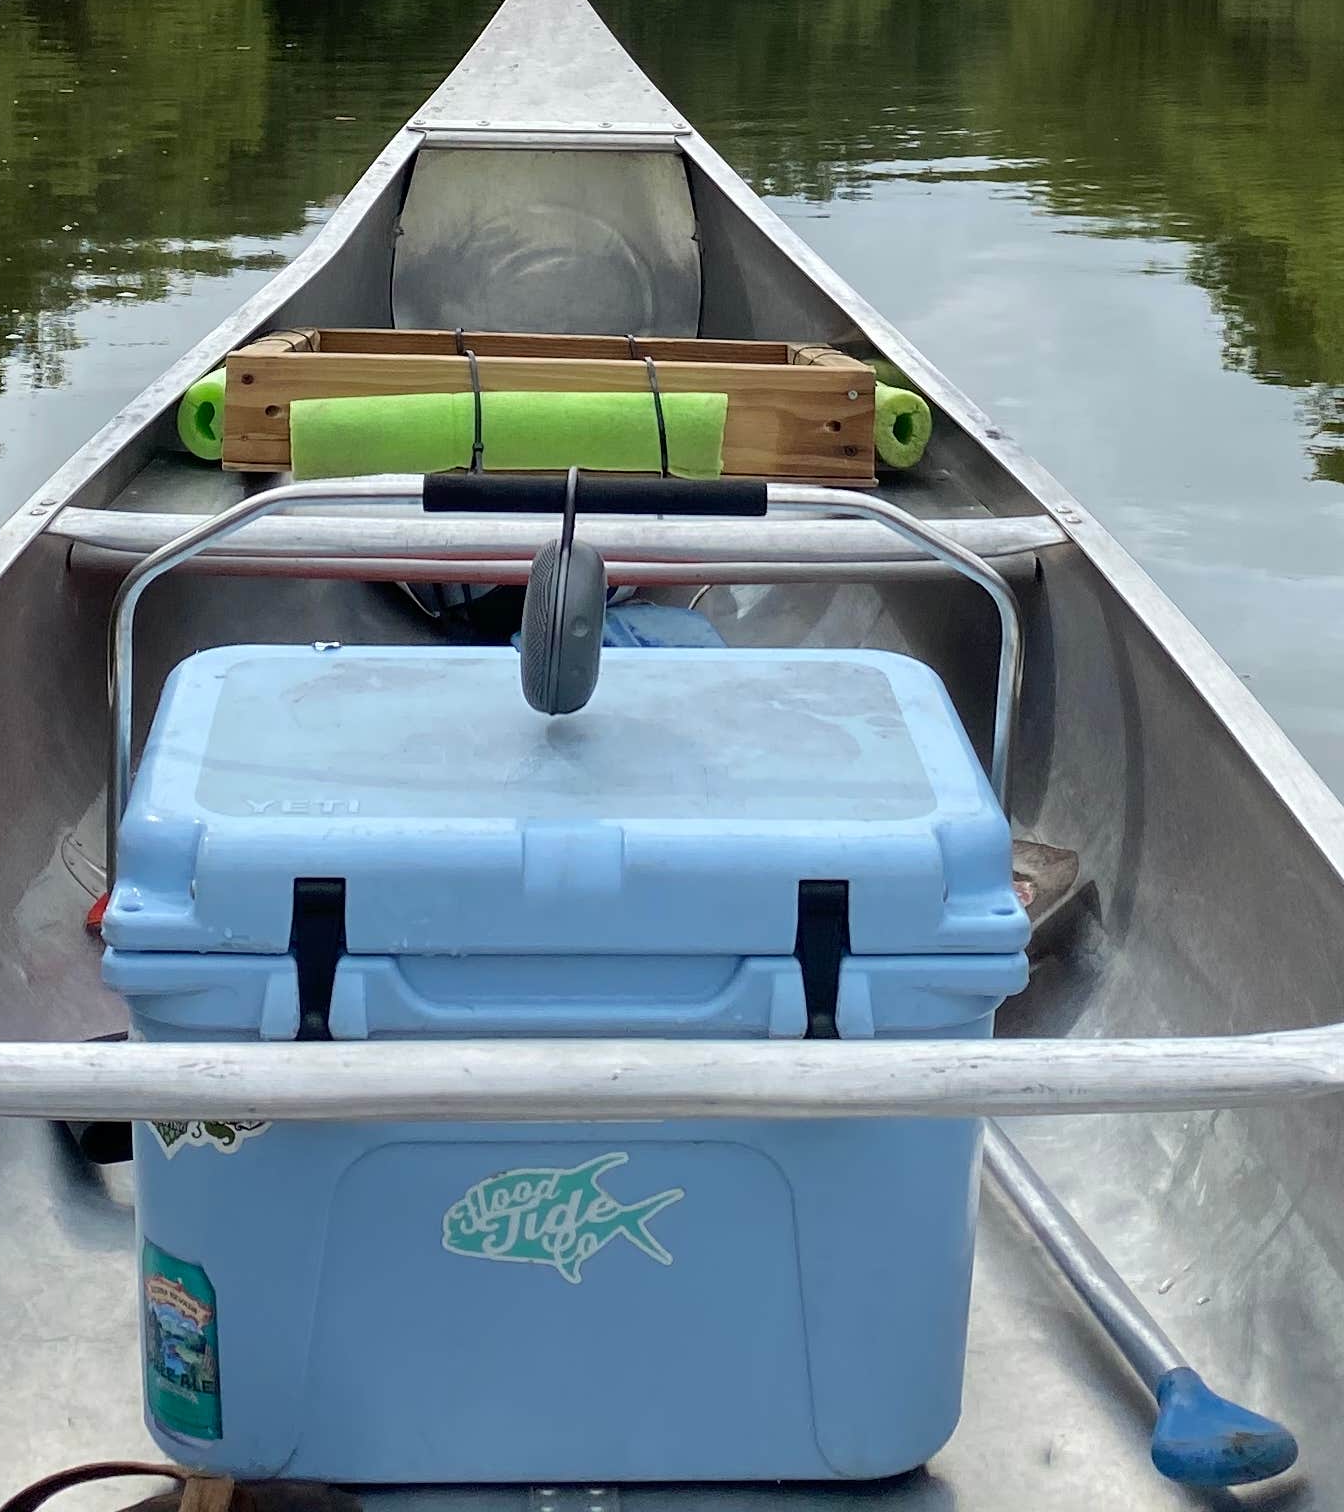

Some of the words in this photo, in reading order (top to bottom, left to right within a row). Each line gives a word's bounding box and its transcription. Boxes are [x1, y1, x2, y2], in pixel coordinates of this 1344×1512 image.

[244, 798, 360, 815] YETI
[451, 1174, 560, 1233] Flood
[480, 1188, 621, 1255] Tide
[542, 1232, 598, 1264] Co
